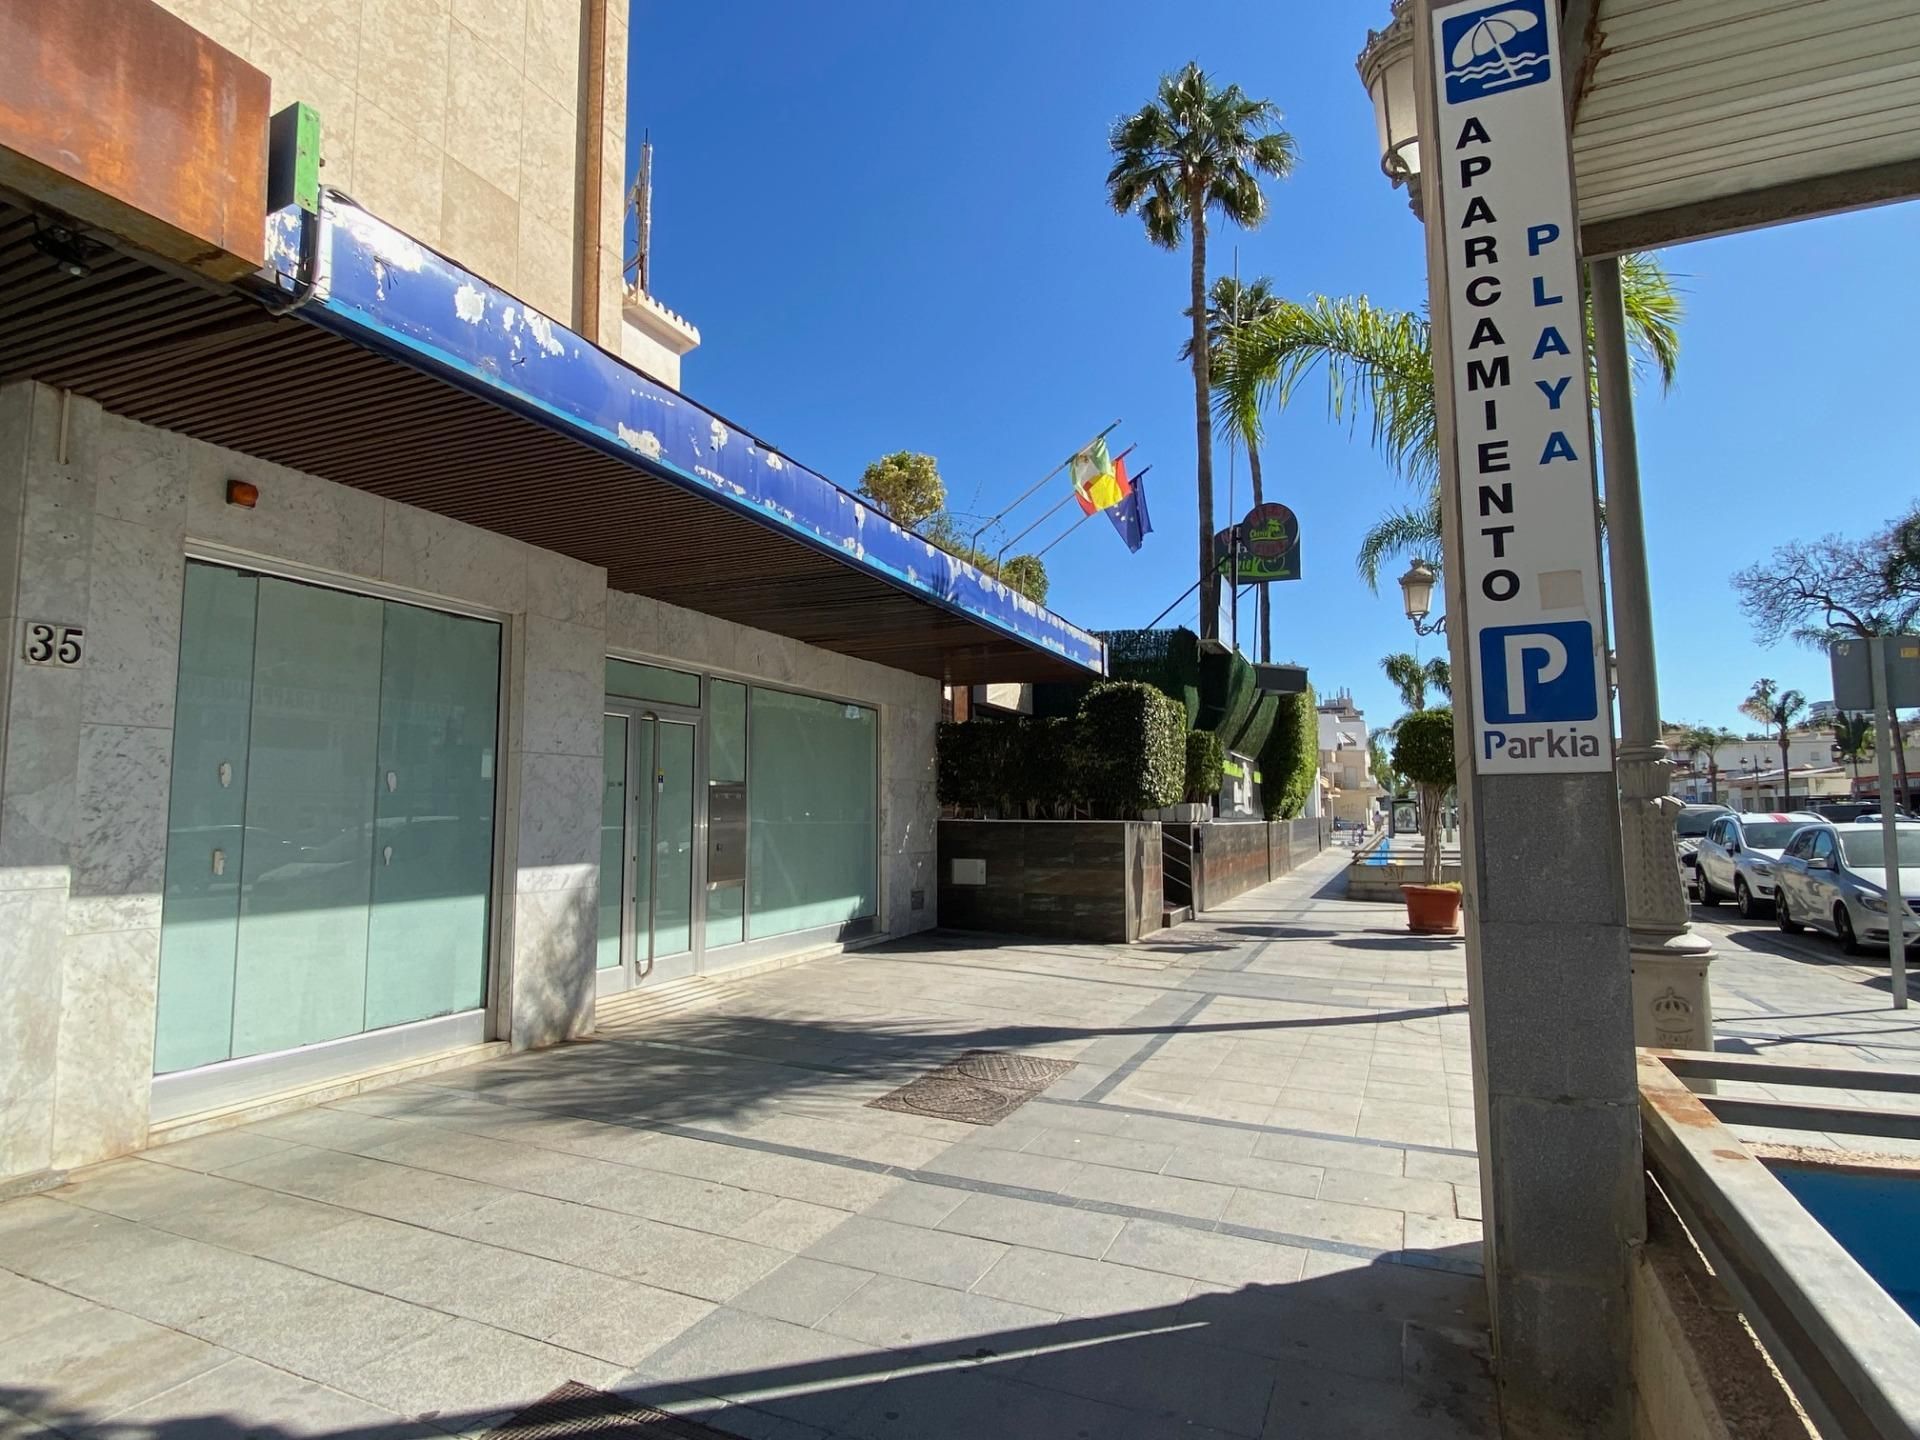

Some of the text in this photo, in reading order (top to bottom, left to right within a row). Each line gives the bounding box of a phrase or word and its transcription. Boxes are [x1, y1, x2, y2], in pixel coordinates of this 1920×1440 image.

[1455, 116, 1521, 602] APARCAMIENTO
[1526, 222, 1579, 466] PLAYA
[28, 624, 84, 665] 35
[1503, 632, 1568, 716] P
[1484, 726, 1600, 760] Parkia
